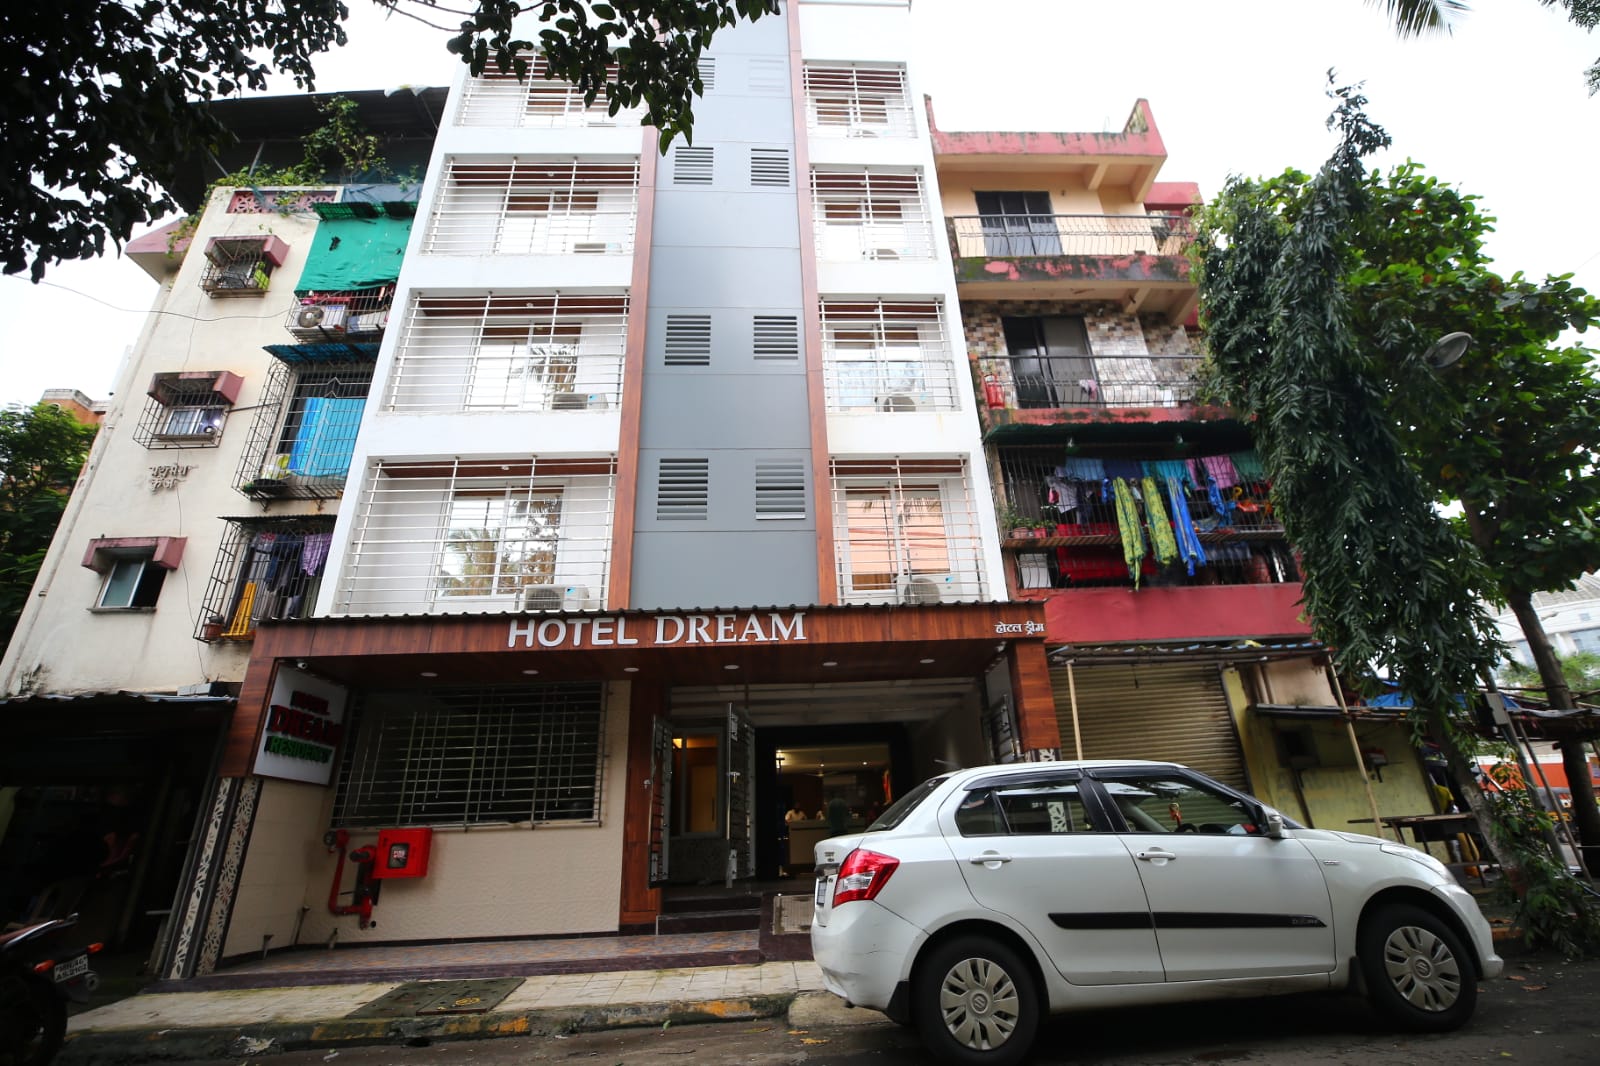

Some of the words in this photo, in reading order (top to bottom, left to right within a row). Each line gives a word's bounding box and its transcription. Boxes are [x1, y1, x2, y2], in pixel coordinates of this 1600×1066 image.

[508, 616, 638, 648] HOTEL
[653, 612, 807, 645] DREAM
[994, 621, 1022, 634] होटल
[1024, 620, 1045, 636] ड्रीम
